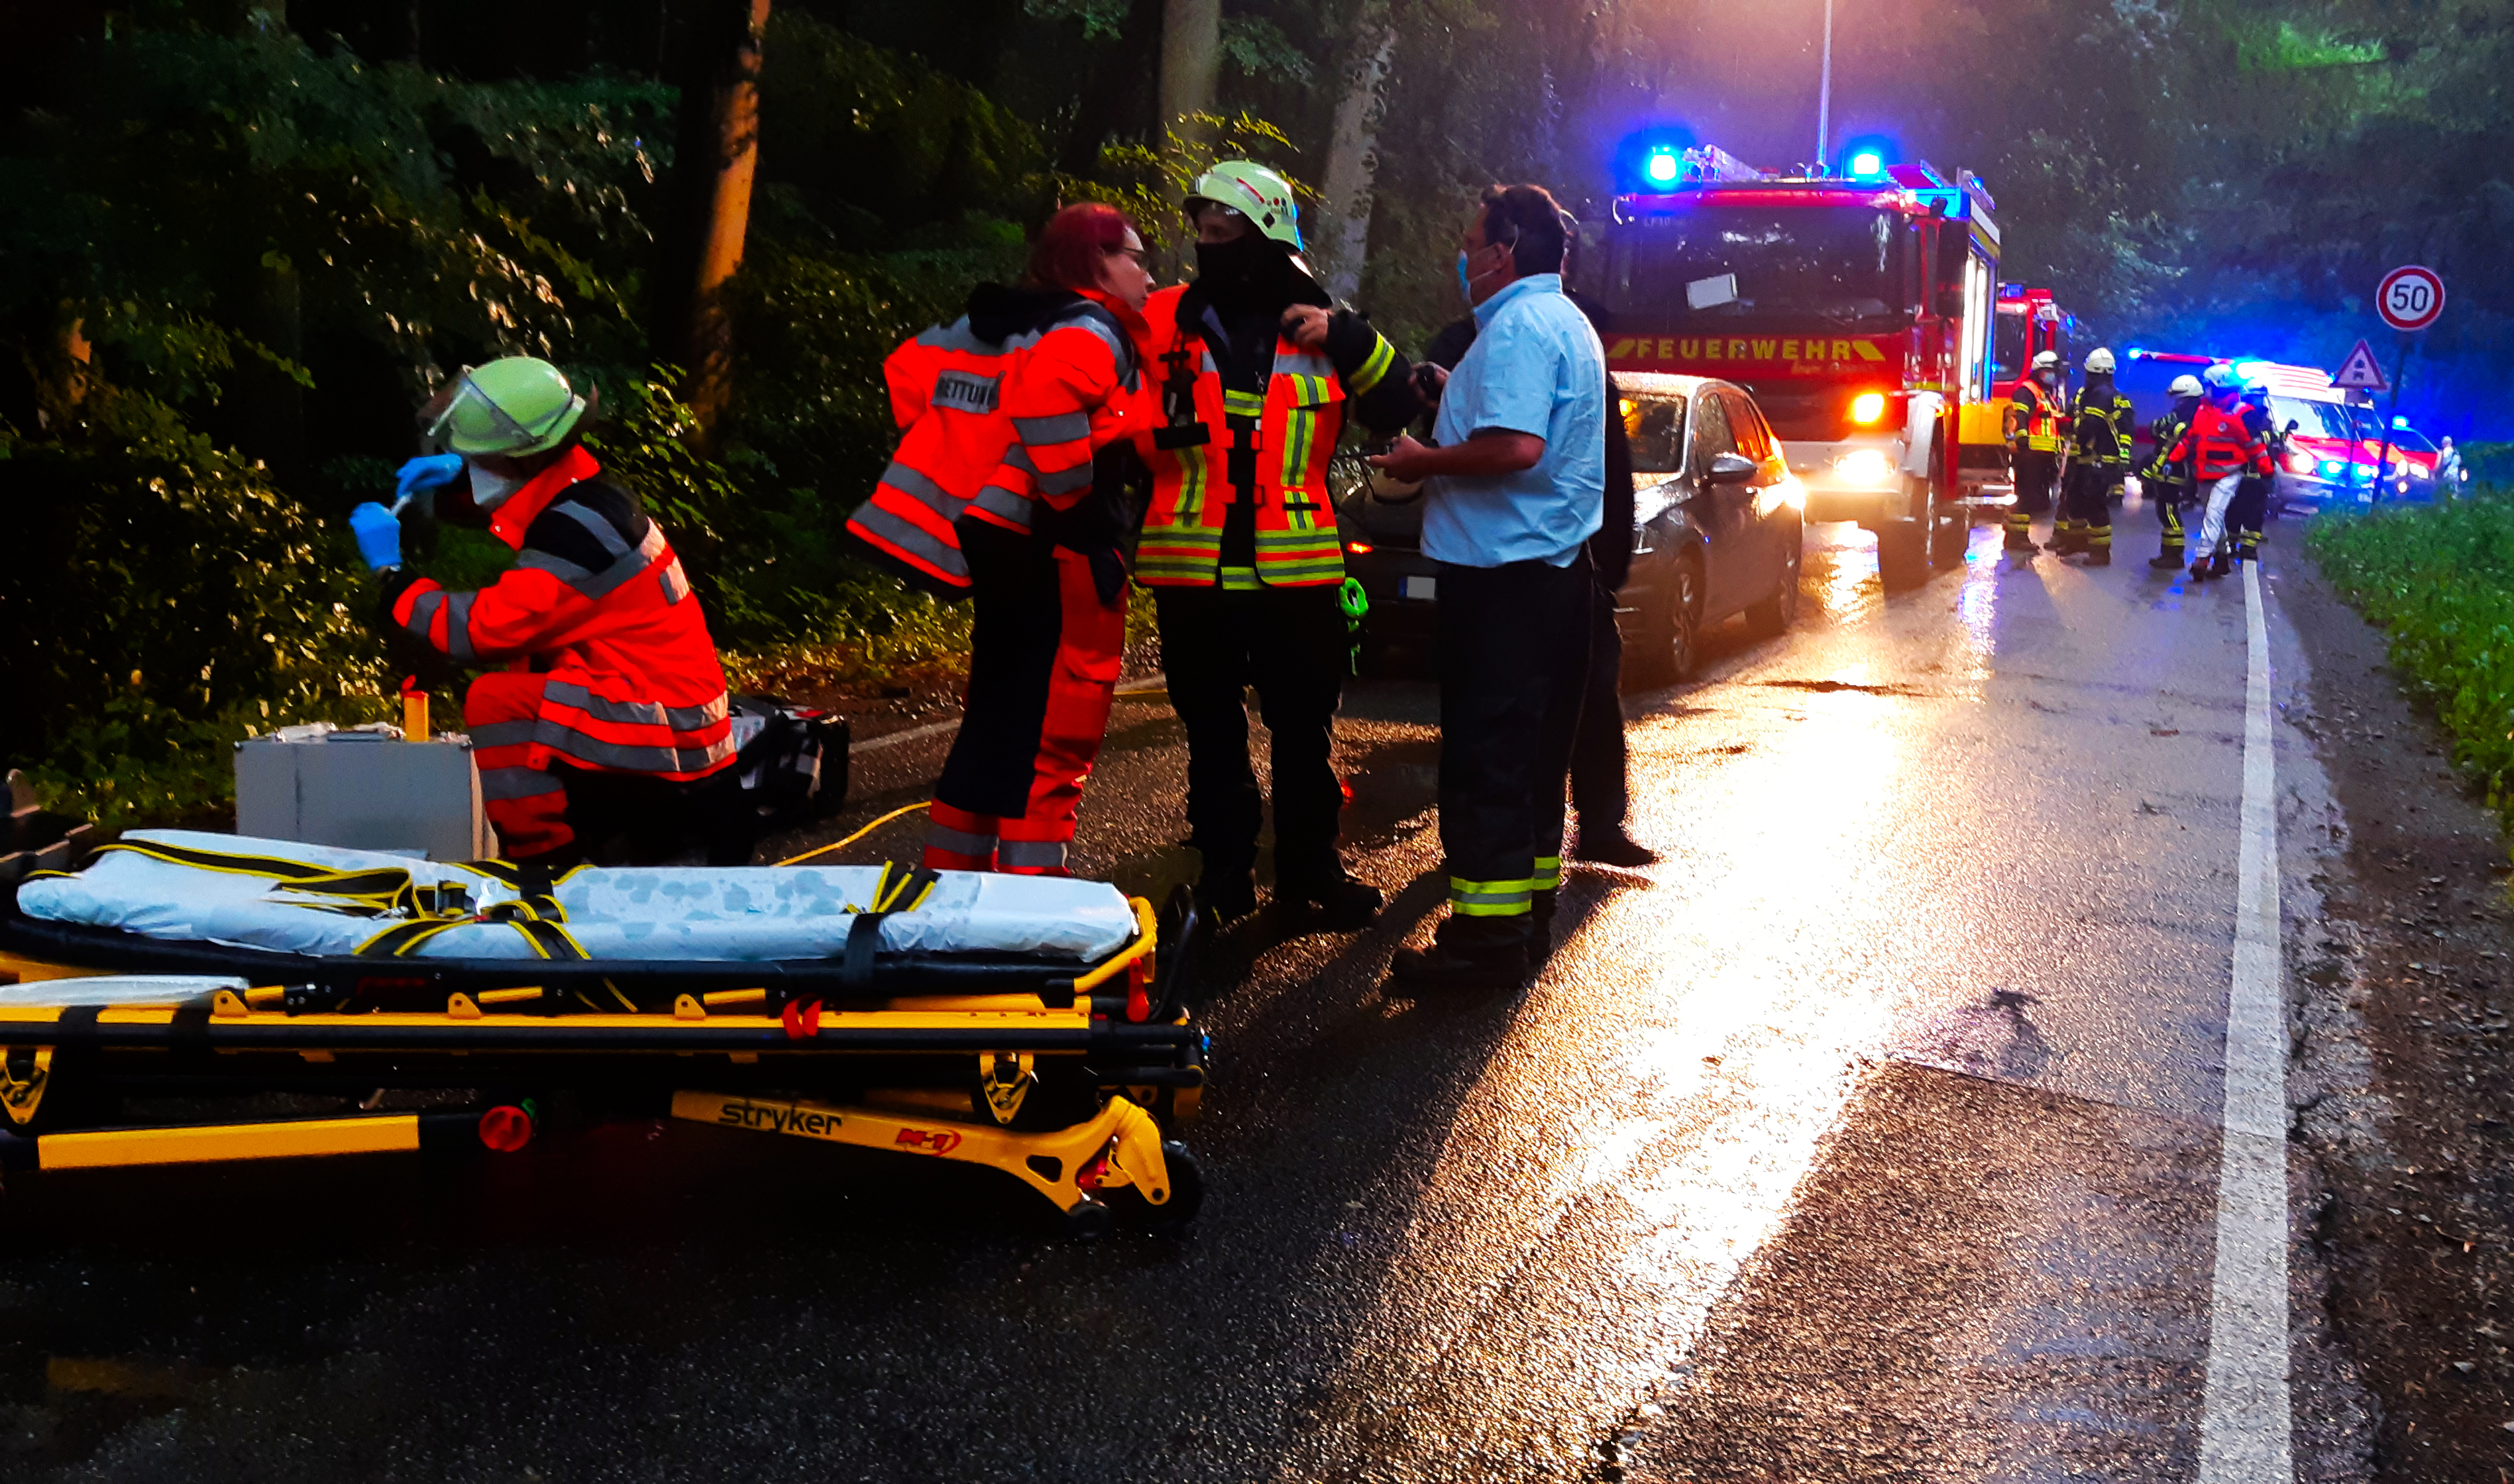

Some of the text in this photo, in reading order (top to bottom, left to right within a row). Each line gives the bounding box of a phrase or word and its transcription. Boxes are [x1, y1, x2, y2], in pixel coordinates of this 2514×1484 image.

[2391, 284, 2429, 312] 50
[1636, 338, 1851, 361] FEUERWEHR
[718, 1099, 842, 1136] stryker
